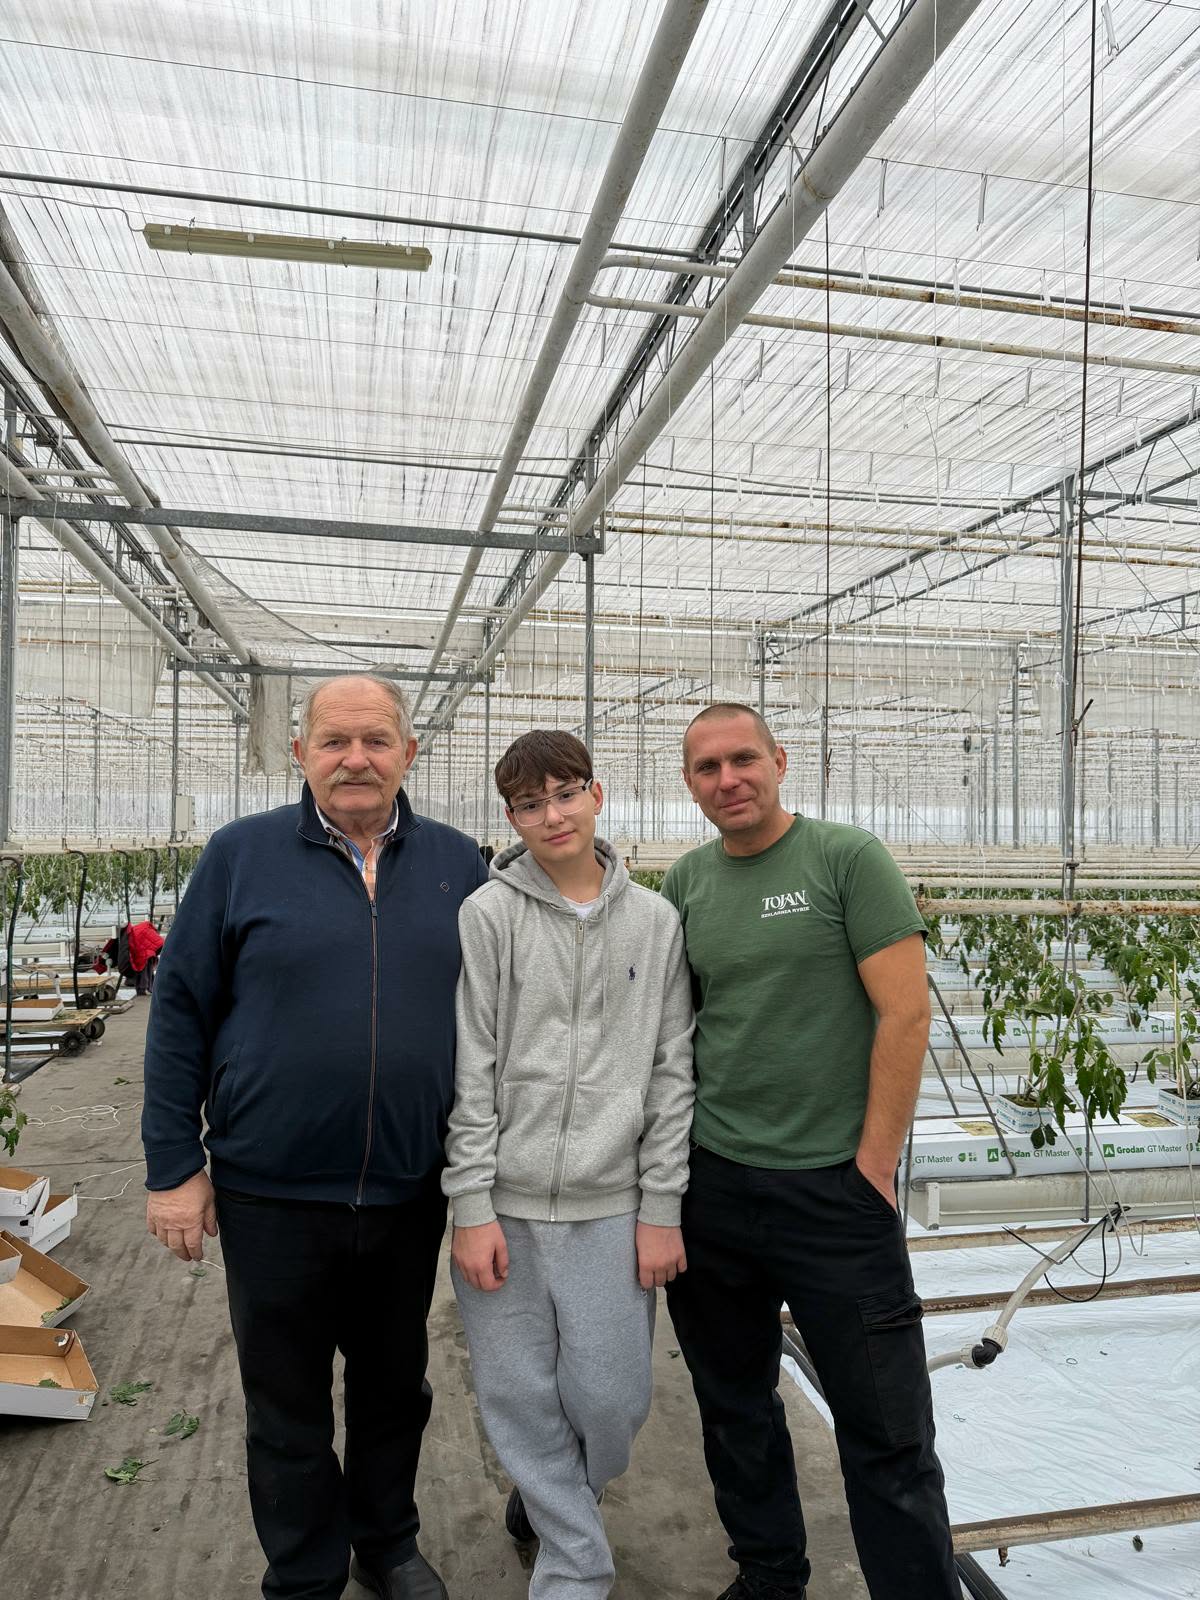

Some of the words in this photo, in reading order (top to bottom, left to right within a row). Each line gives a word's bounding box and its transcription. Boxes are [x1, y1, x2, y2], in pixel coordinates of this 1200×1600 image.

[762, 890, 809, 910] TOJAN
[1000, 1149, 1031, 1158] Godan
[1033, 1150, 1044, 1158] GT
[1045, 1148, 1070, 1157] Master
[1116, 1146, 1145, 1154] Grodan
[1147, 1145, 1157, 1153] GT
[1158, 1144, 1182, 1153] Master
[915, 1155, 926, 1164] GT
[927, 1154, 953, 1163] Master
